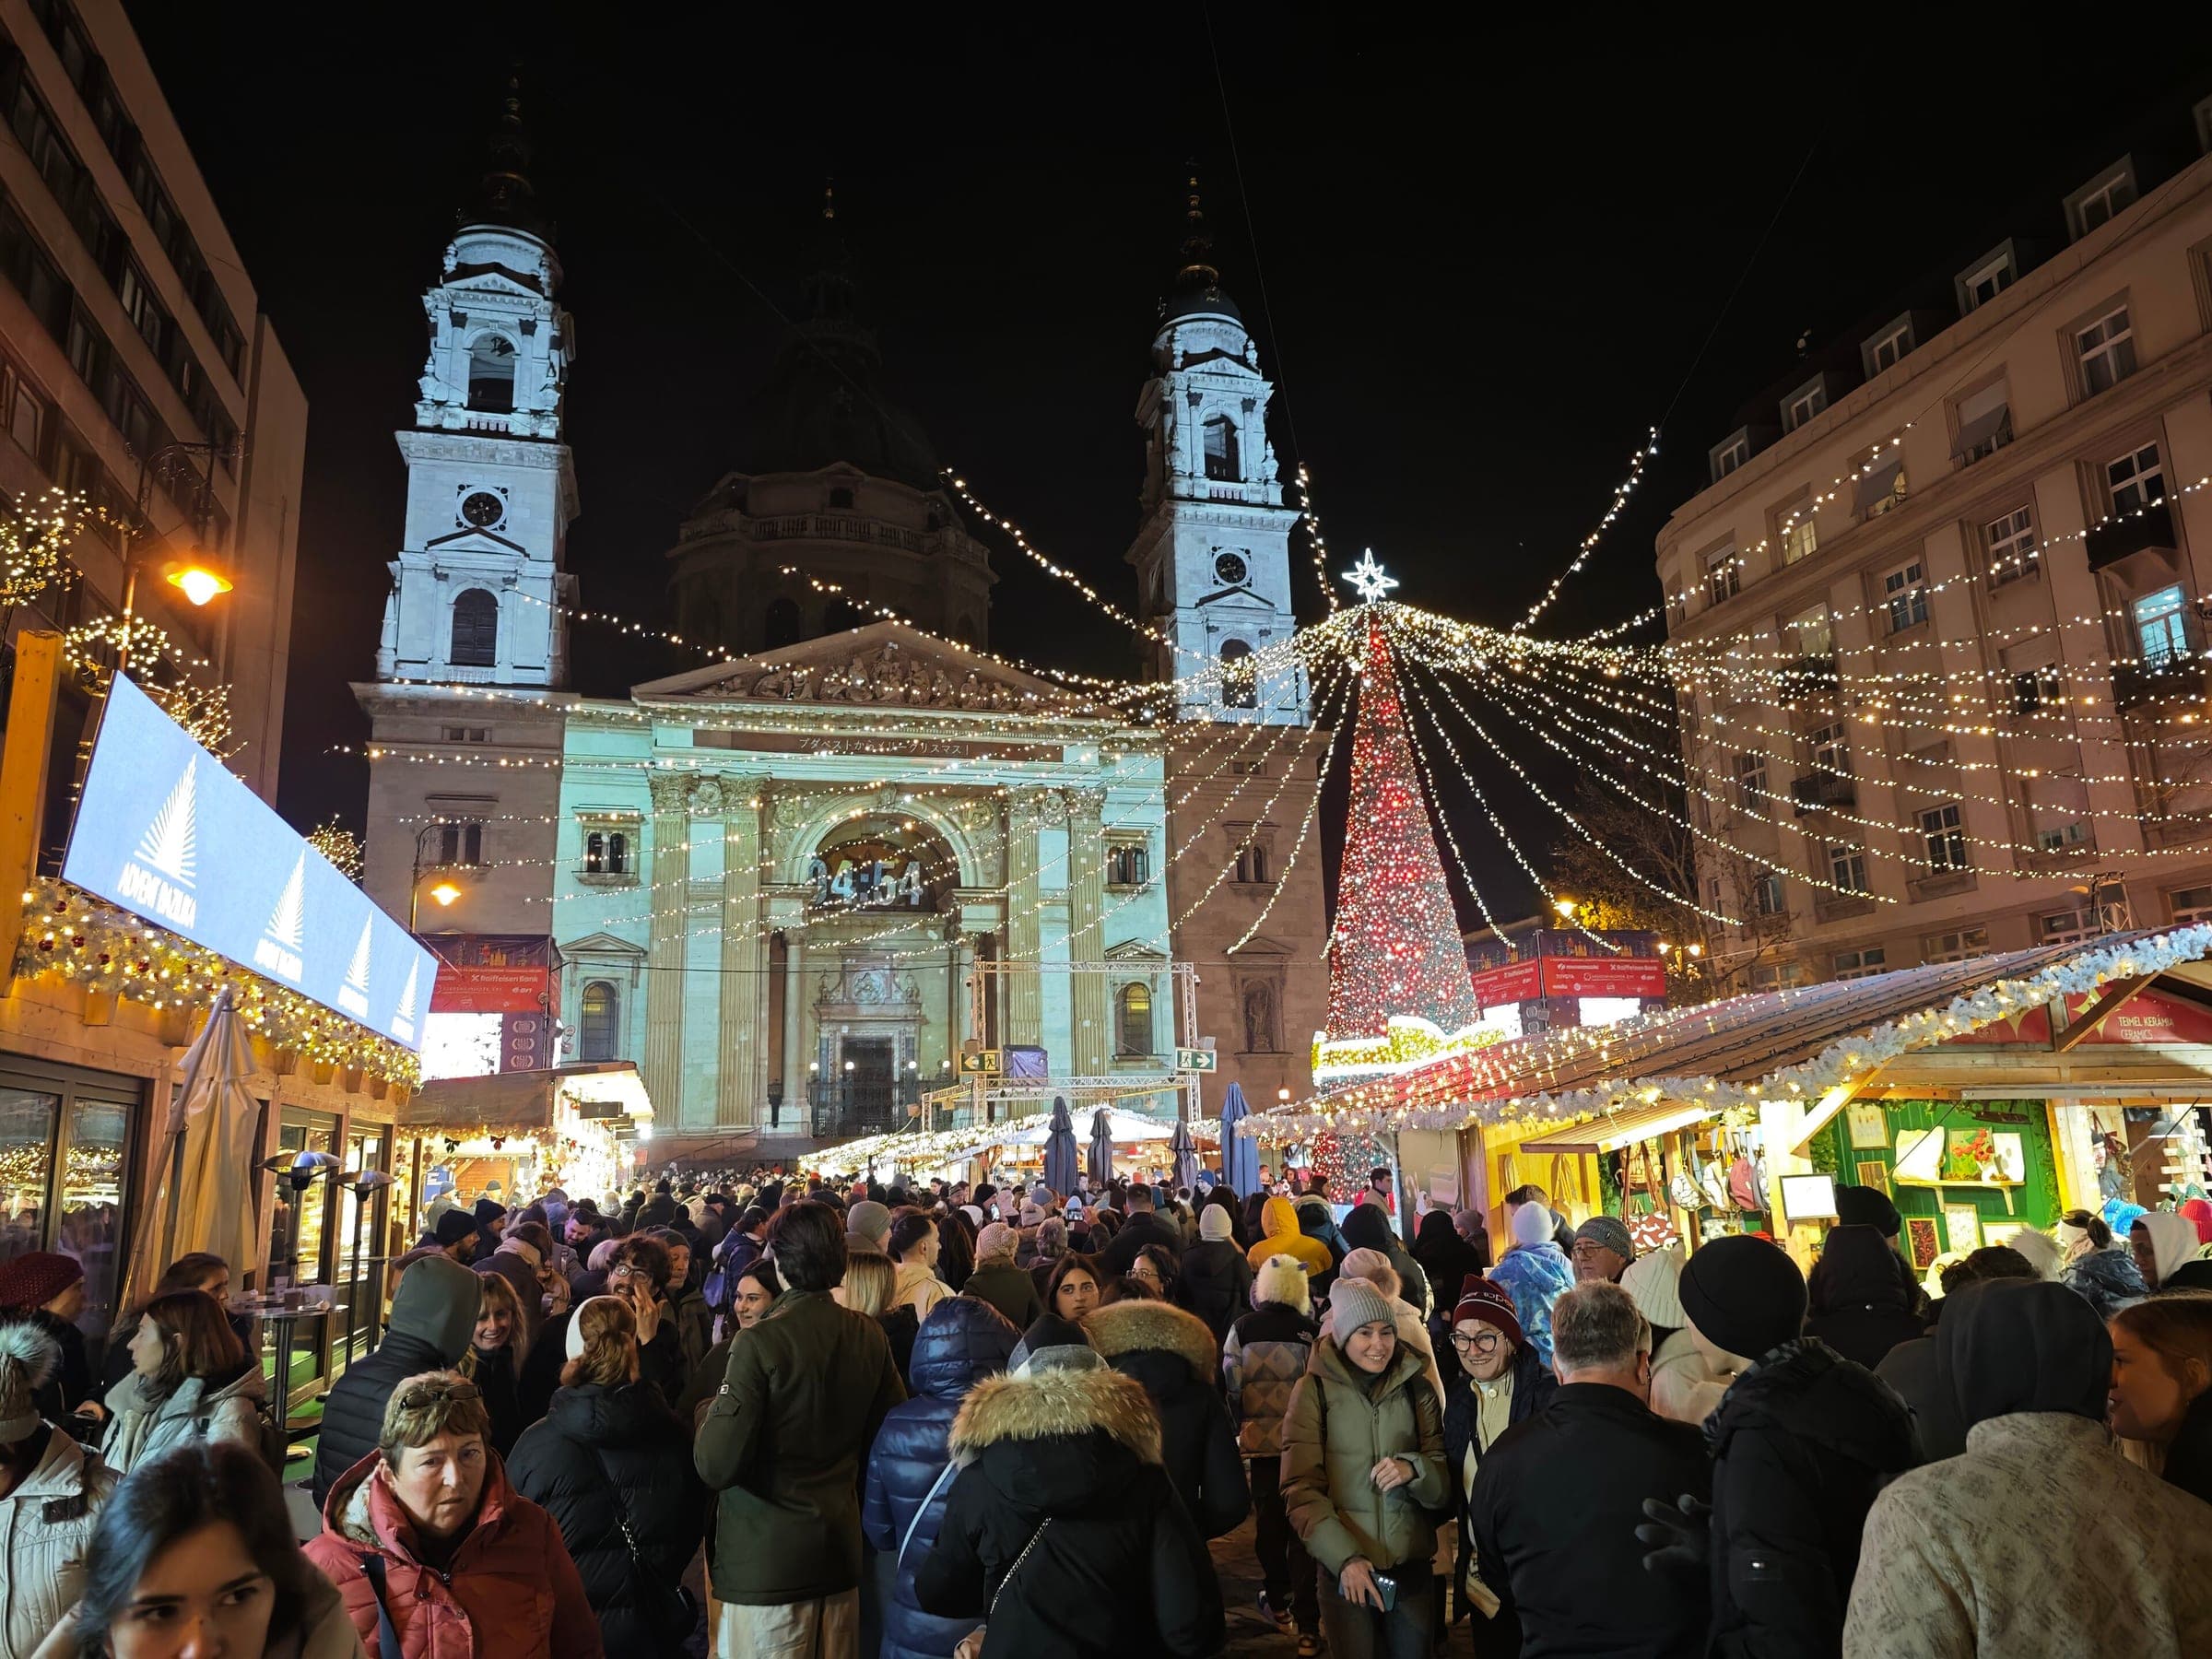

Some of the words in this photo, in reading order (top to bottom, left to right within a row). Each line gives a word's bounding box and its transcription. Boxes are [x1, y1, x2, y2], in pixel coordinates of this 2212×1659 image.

[480, 974, 519, 982] Raiffeisen
[519, 974, 538, 982] Bank
[2120, 1029, 2153, 1041] CERAMICS
